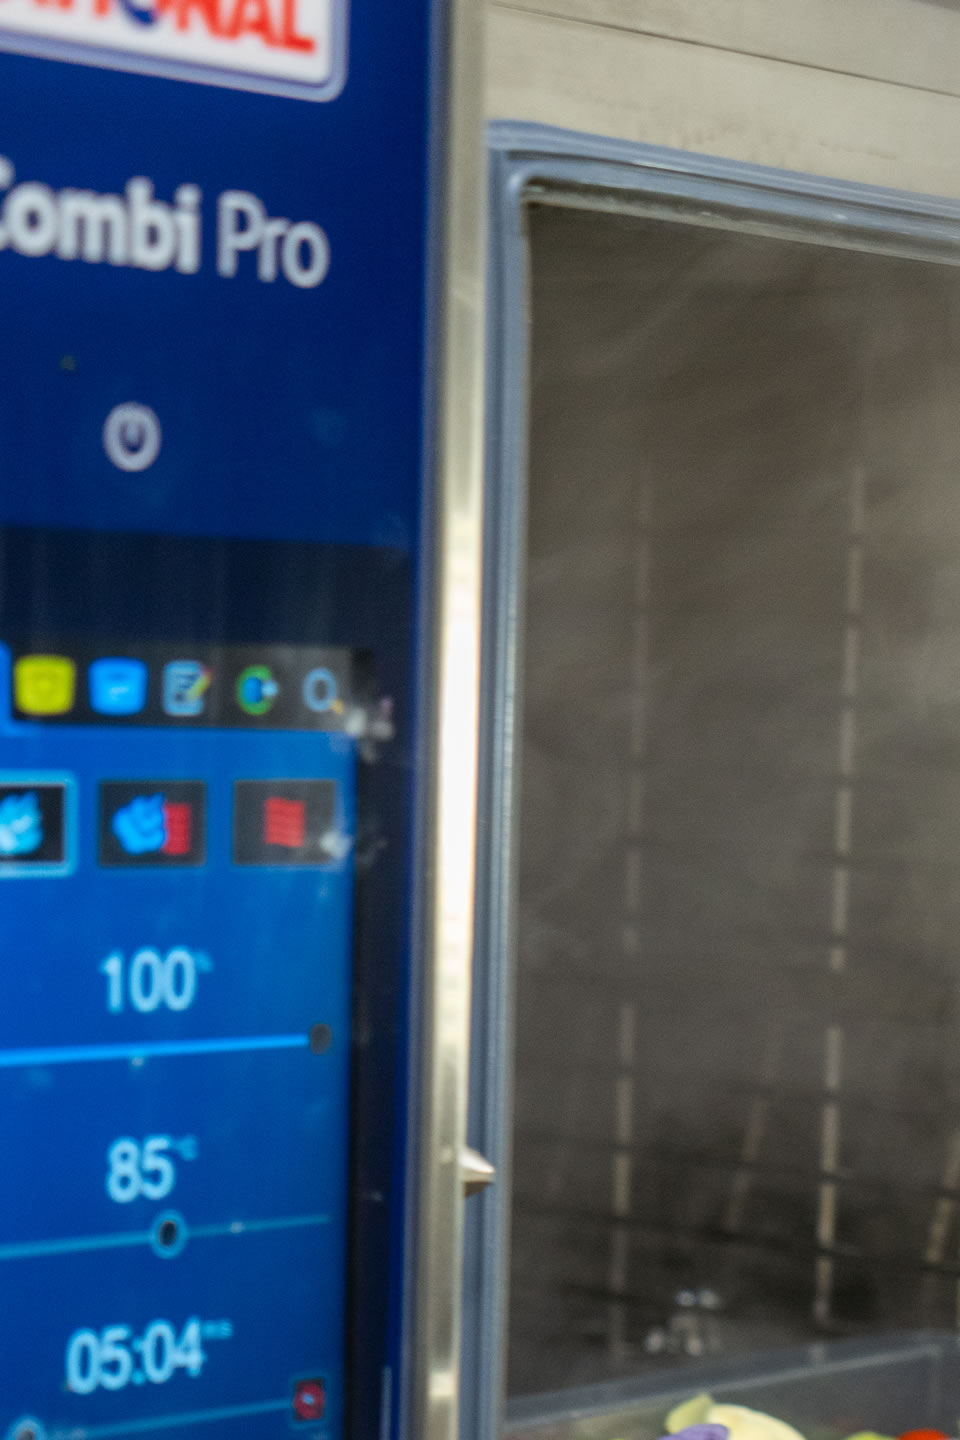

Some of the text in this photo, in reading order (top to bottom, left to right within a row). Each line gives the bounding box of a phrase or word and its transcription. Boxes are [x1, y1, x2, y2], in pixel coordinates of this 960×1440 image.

[0, 157, 331, 290] ombi Pro
[101, 946, 197, 1013] 100
[66, 1316, 206, 1394] 05:04
